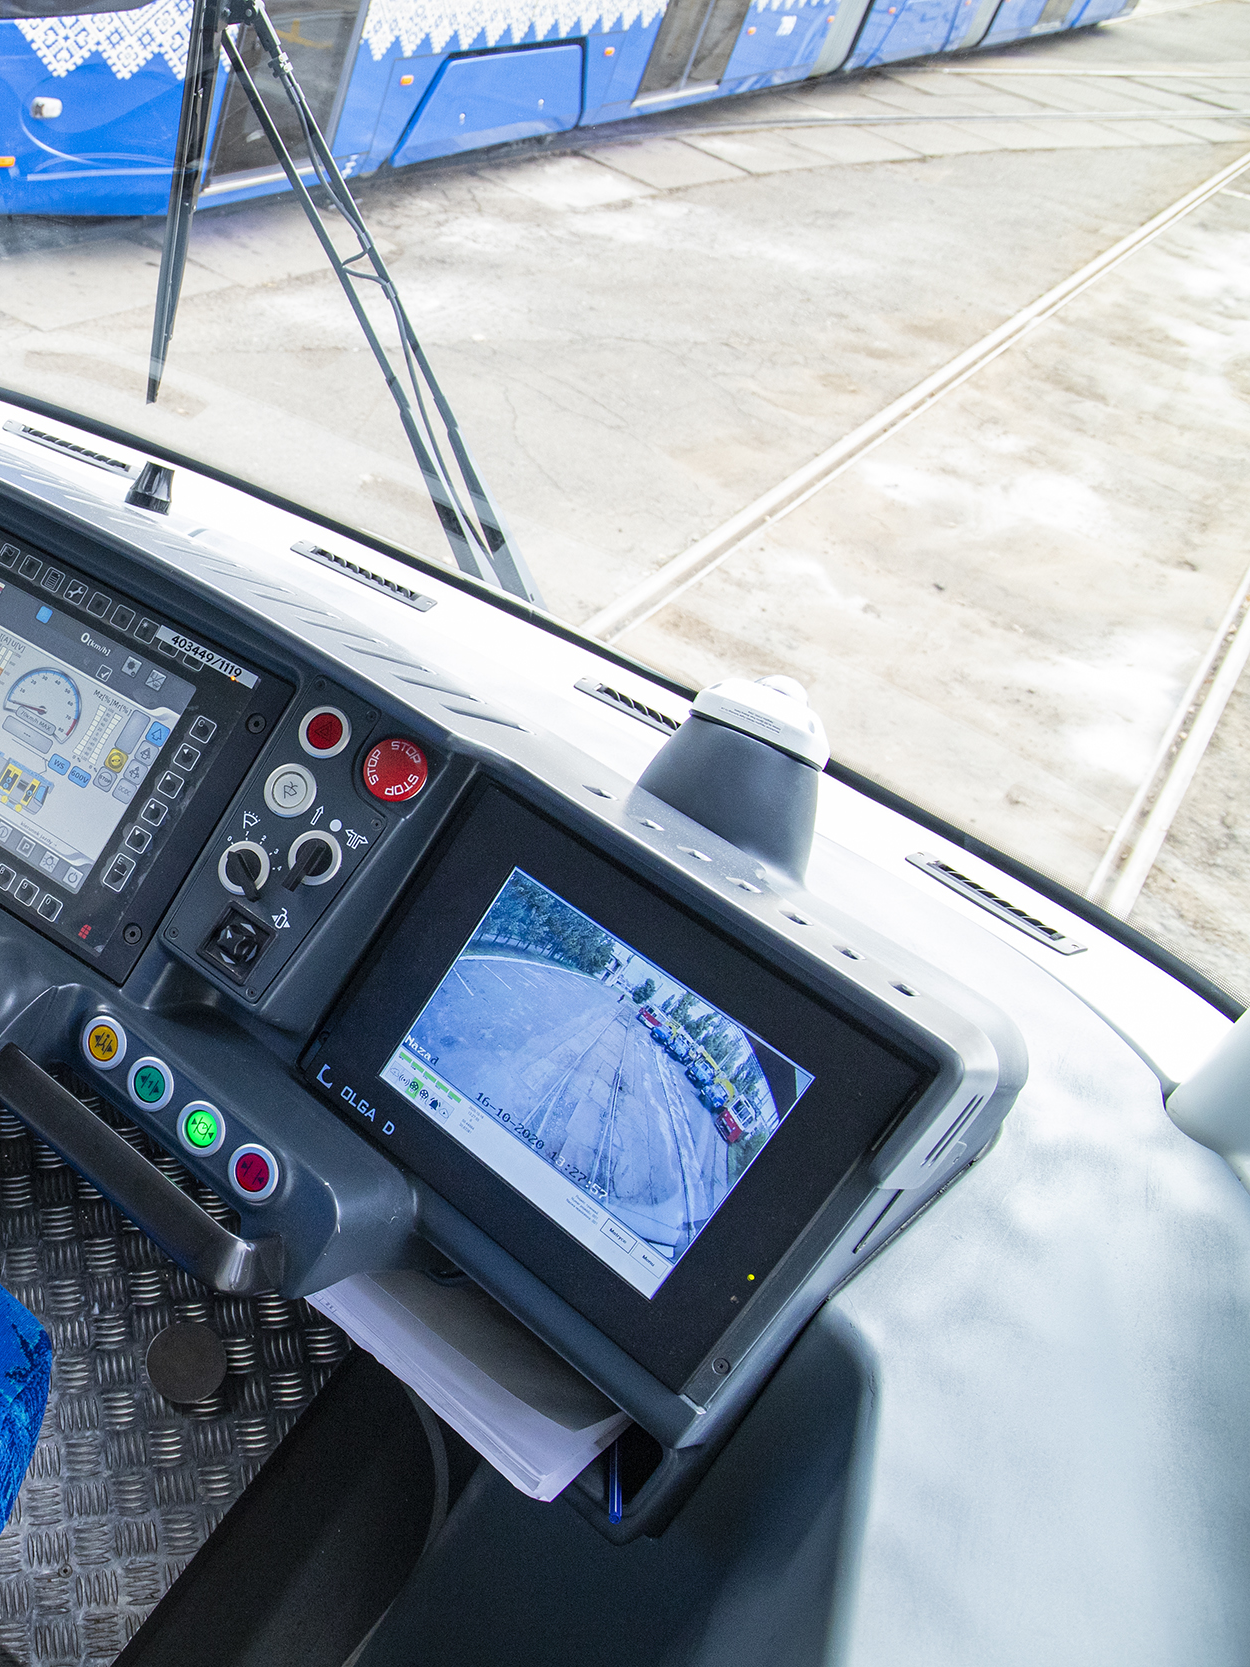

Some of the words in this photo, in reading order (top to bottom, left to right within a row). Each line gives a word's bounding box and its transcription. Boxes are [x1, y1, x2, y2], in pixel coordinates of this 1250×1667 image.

[171, 635, 242, 678] 403449/1119
[39, 720, 52, 732] MAX
[53, 759, 66, 770] WS
[391, 741, 421, 764] STOP
[70, 770, 89, 783] 600V
[367, 749, 381, 786] STOP
[384, 774, 419, 795] STOP
[404, 1034, 440, 1066] Nazad
[340, 1086, 376, 1122] OLGA
[382, 1121, 395, 1135] D
[475, 1092, 545, 1150] 16-10-2020
[550, 1151, 608, 1199] 13:27:57
